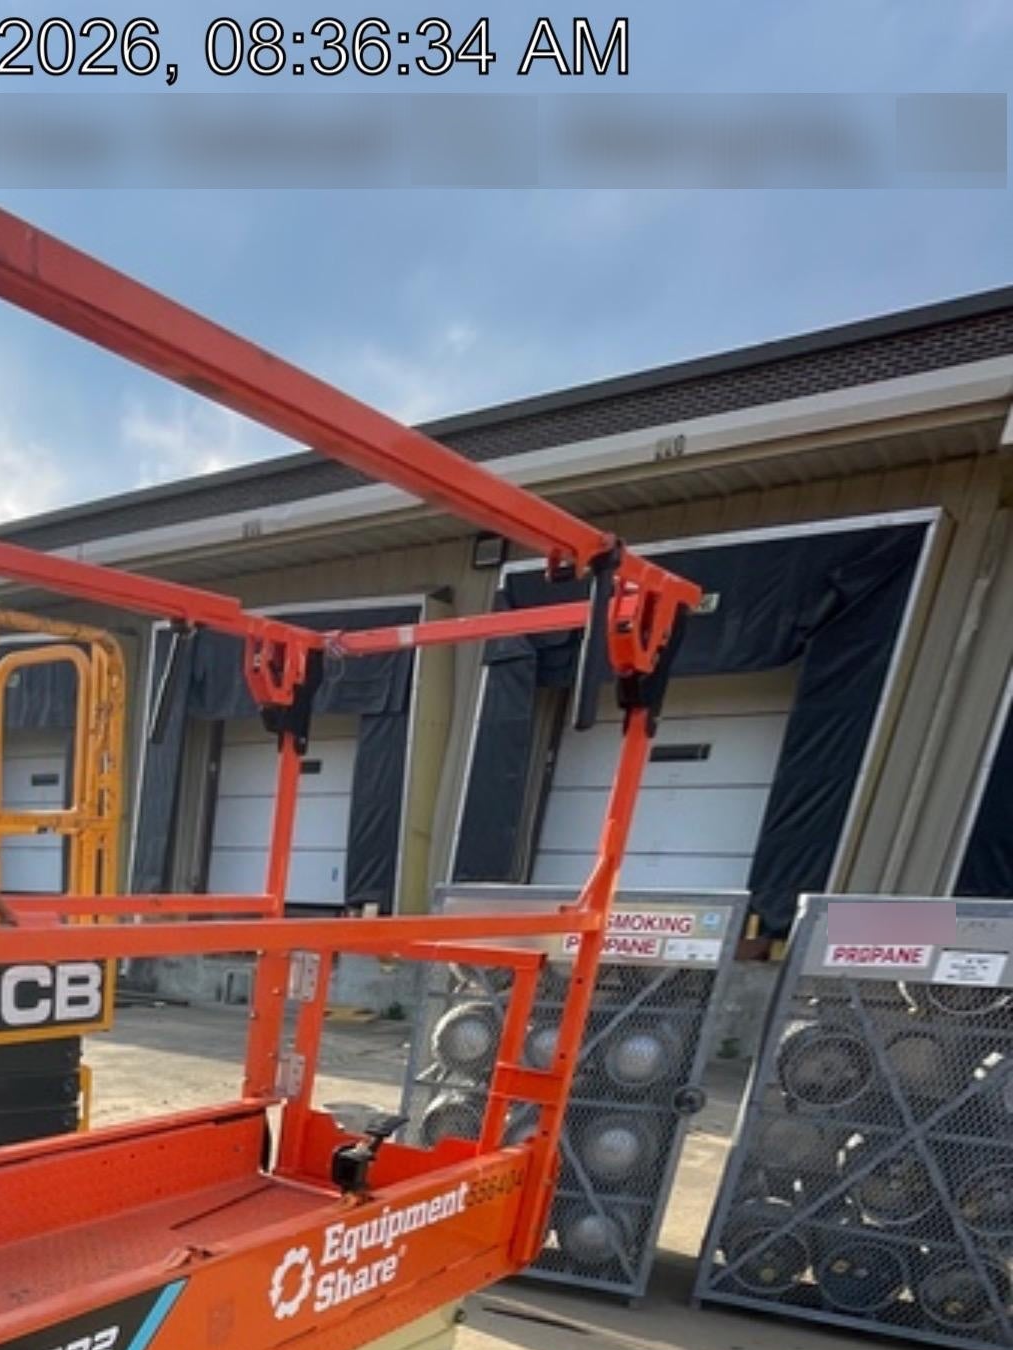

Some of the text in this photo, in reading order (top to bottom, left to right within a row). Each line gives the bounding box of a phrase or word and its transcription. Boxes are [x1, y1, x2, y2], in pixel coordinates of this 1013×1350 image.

[566, 934, 657, 955] PPANE
[833, 946, 924, 964] PROPANE
[321, 1181, 470, 1266] Equipment
[314, 1253, 399, 1313] Share
